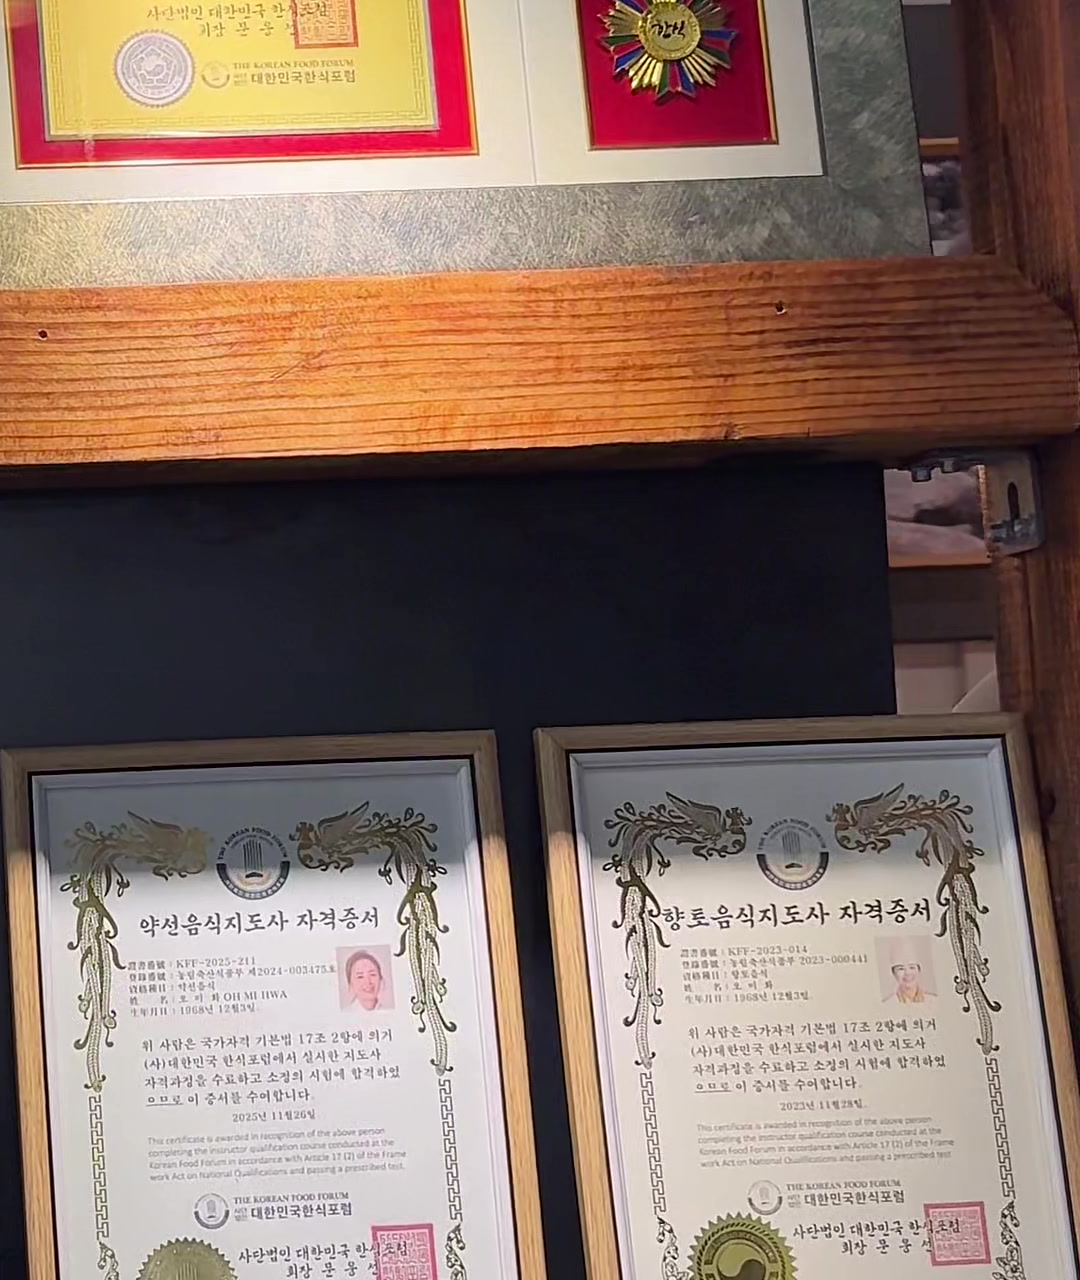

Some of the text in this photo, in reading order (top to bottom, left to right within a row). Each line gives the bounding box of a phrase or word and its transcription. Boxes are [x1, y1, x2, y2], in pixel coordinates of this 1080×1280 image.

[251, 70, 356, 84] 대한민국한식포럼
[139, 906, 380, 938] 약선음식지도사 자격증서
[662, 898, 931, 931] 향토음식지도사 자격증서
[746, 1024, 795, 1038] 국가자격
[200, 1035, 250, 1050] 국가자격
[889, 1036, 926, 1050] 지도사
[344, 1047, 382, 1062] 지도사
[234, 1192, 349, 1204] THE KOREAN FOOD FORUM
[804, 1190, 905, 1207] 대한민국한식포럼
[251, 1202, 352, 1220] 대한민국한식포럼
[793, 1222, 845, 1239] 사단법인
[850, 1220, 904, 1237] 대한민국
[239, 1245, 291, 1264] 사단법인
[296, 1243, 351, 1261] 대한민국
